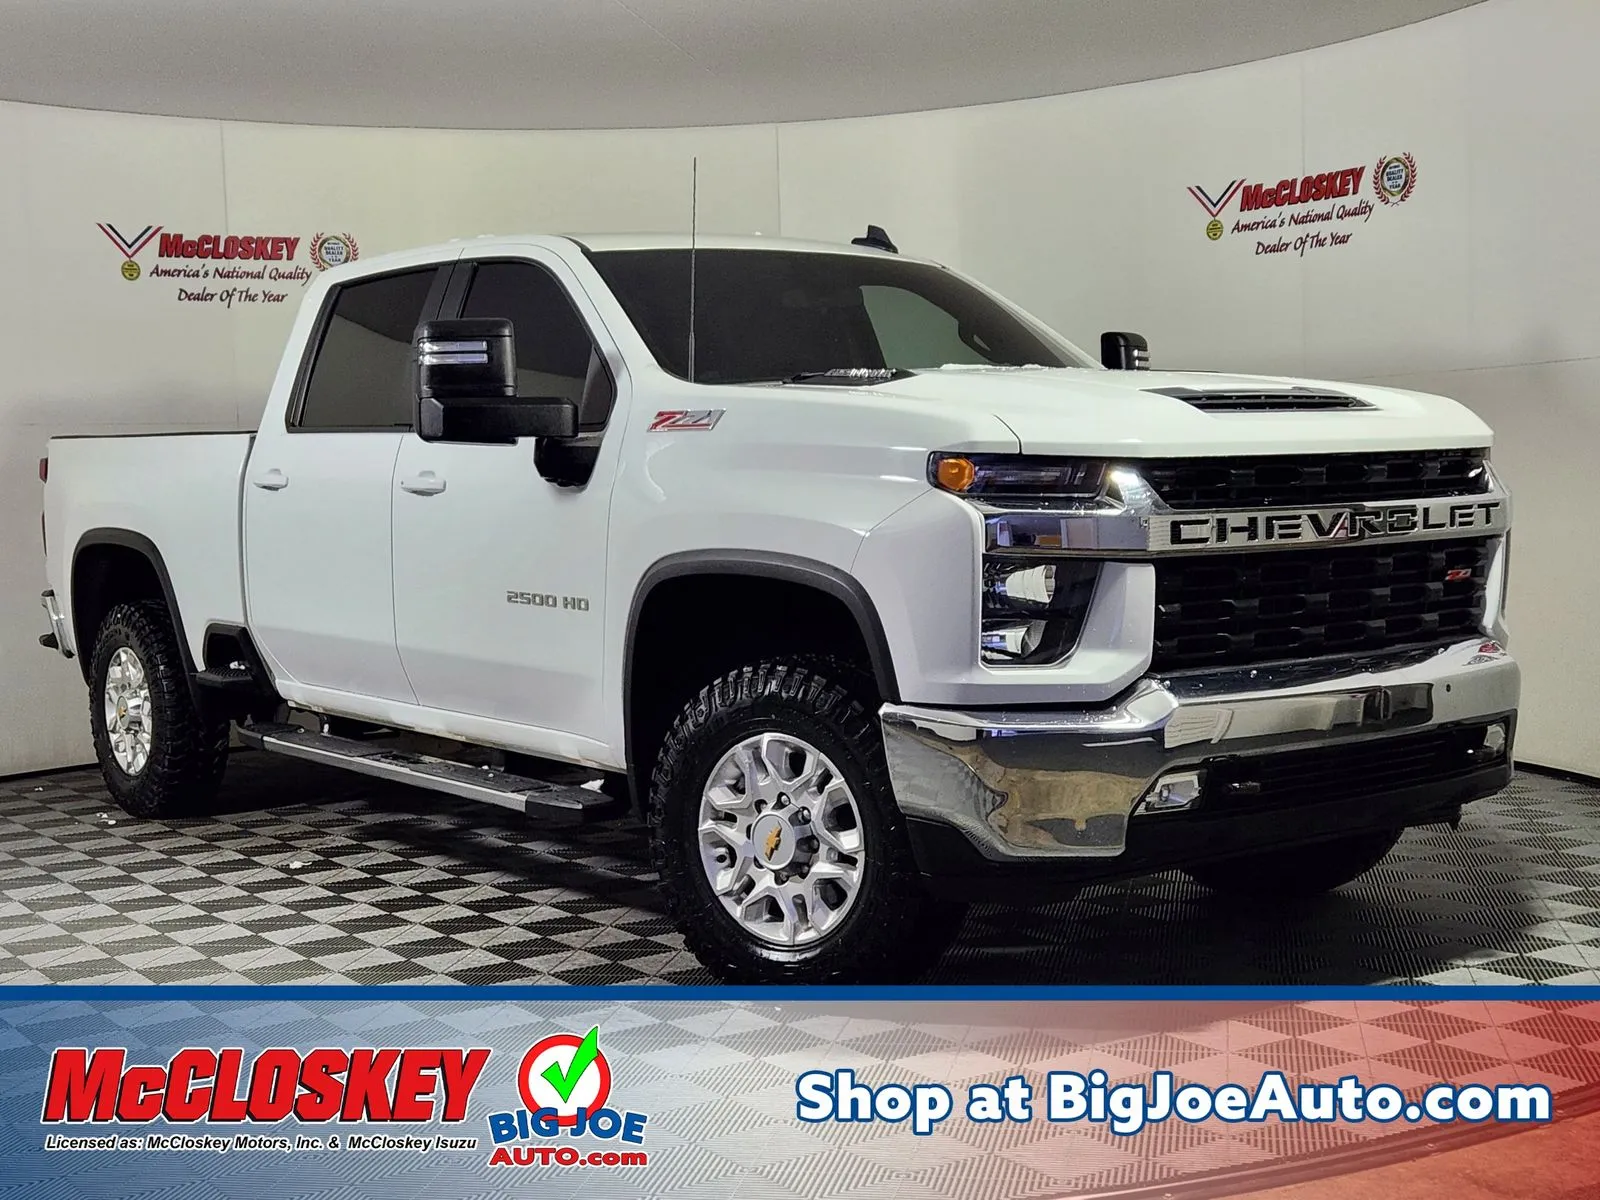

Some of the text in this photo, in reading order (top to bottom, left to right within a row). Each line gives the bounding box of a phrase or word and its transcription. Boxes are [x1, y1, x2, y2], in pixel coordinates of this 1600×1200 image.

[1239, 166, 1366, 212] McCLOSKEY
[1231, 212, 1285, 234] America's
[1288, 203, 1334, 227] National
[1336, 198, 1375, 223] Quality
[158, 233, 300, 261] McCLOSKEY
[1255, 231, 1352, 257] Dealer Of The Year
[149, 263, 210, 279] America's
[213, 266, 266, 280] National
[268, 268, 313, 286] Quality
[177, 287, 288, 308] Dealer Of The Year
[1169, 502, 1501, 545] CHEVROLET
[506, 590, 589, 611] 2500 HD
